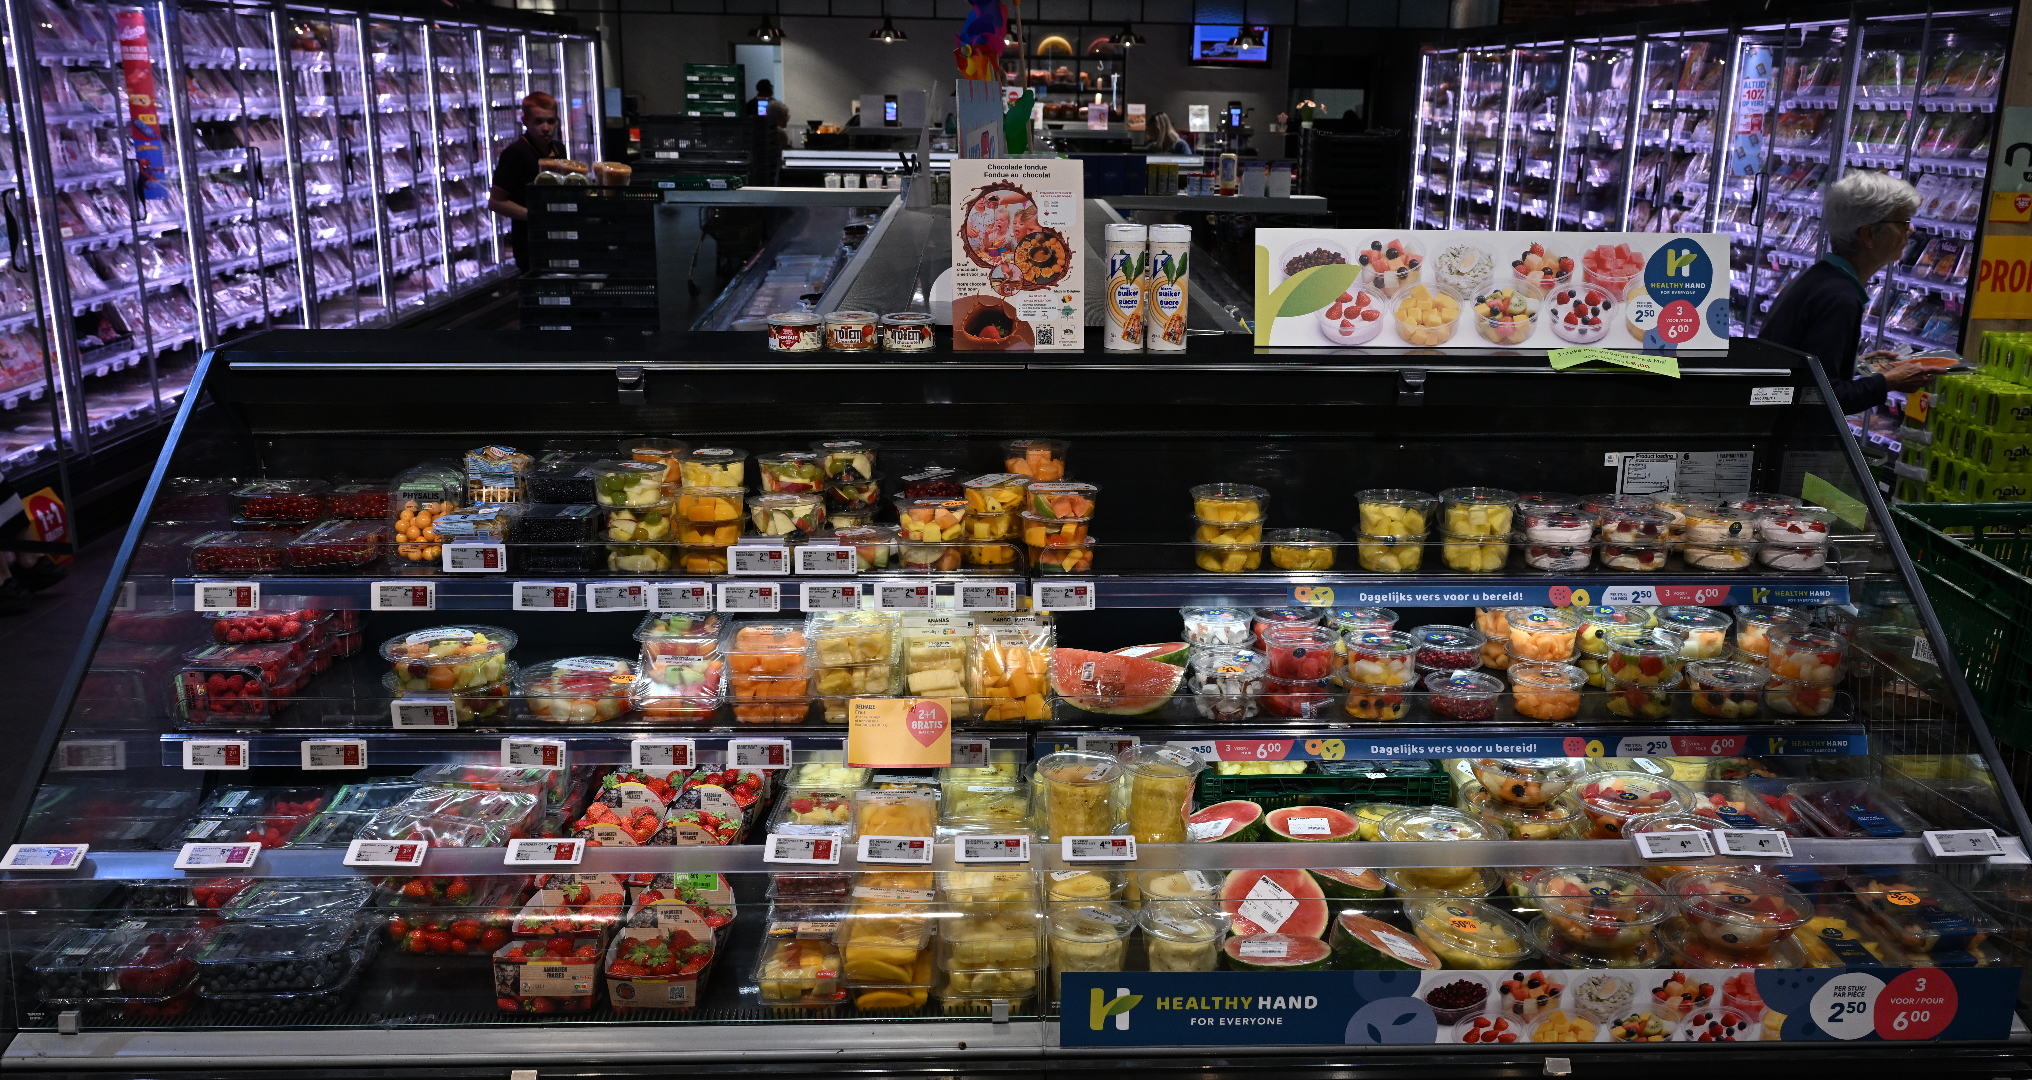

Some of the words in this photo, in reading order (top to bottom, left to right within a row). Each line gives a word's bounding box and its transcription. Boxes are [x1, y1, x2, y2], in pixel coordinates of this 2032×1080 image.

[1743, 80, 1766, 89] ALTIJD
[1742, 88, 1765, 100] -10%
[987, 163, 1022, 171] Chocolade
[1023, 163, 1048, 171] fondue
[1022, 171, 1051, 179] chocolat
[1977, 259, 2032, 293] PRO
[1676, 306, 1683, 316] 3
[403, 492, 439, 500] PHYSALIS
[1992, 484, 2026, 500] nalu
[1358, 591, 1413, 604] Dagelijks
[1415, 592, 1442, 602] vers
[1443, 592, 1471, 601] voor
[1473, 592, 1480, 601] u
[1482, 590, 1523, 602] bereid!
[1665, 589, 1671, 597] 3
[918, 709, 936, 720] 2+1
[911, 720, 943, 730] GRATIS
[1225, 744, 1231, 752] 3
[1680, 739, 1685, 747] 3
[1370, 743, 1425, 756] Dagelijks
[1427, 745, 1453, 754] vers
[1455, 744, 1482, 753] voor
[1485, 744, 1493, 753] u
[1494, 743, 1538, 753] bereid!
[1449, 919, 1476, 931] -50%
[1914, 977, 1927, 992] 3
[1847, 990, 1865, 998] PIÈCE
[1156, 995, 1253, 1010] HEALTHY
[1257, 994, 1319, 1010] HAND
[1890, 997, 1914, 1005] VOOR
[1920, 997, 1944, 1005] POUR
[1190, 1017, 1214, 1026] FOR
[1219, 1016, 1283, 1026] EVERYONE
